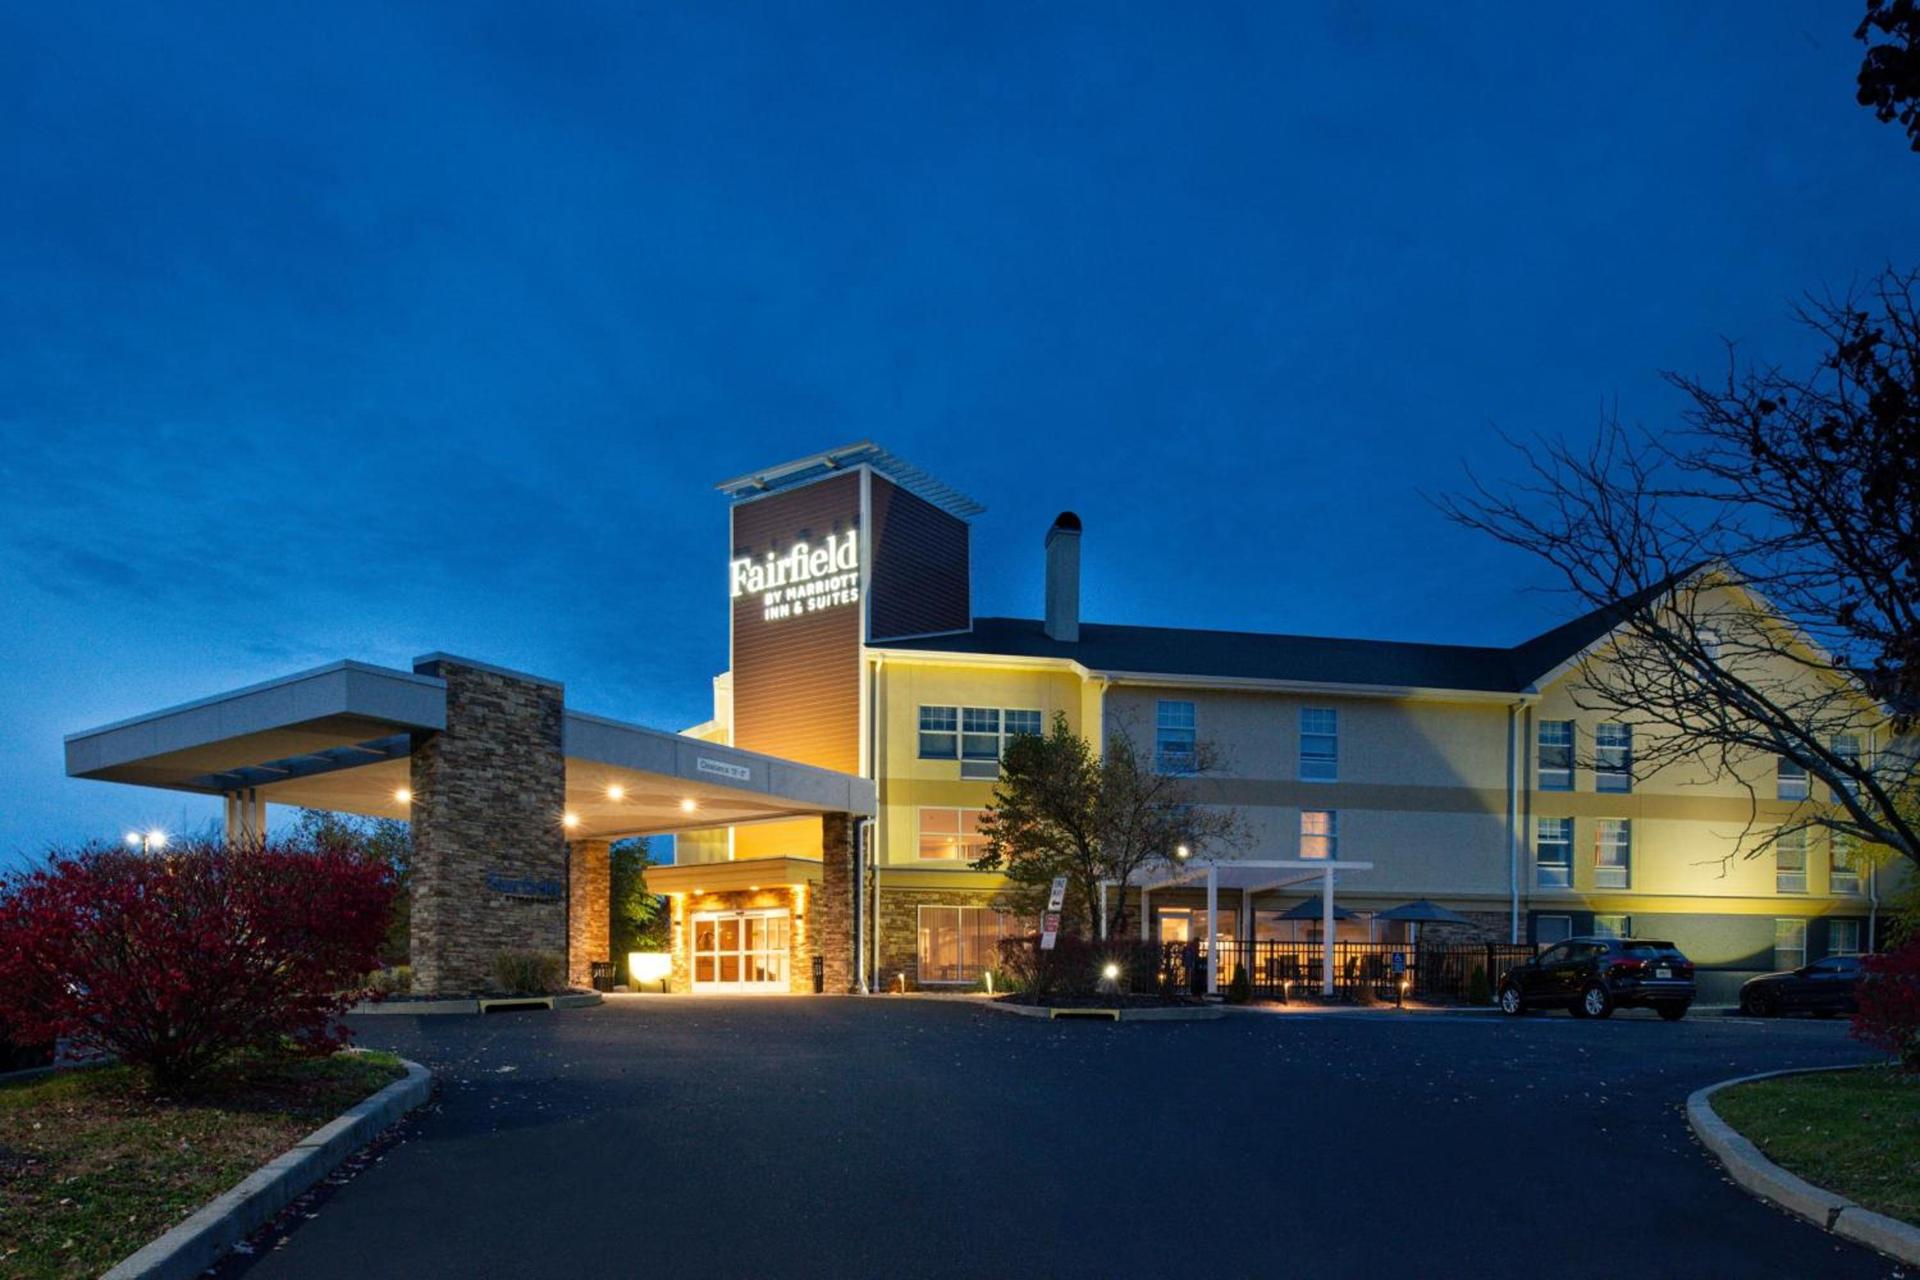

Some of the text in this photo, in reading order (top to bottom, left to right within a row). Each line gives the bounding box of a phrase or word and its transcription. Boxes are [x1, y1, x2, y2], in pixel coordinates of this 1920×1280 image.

[729, 529, 858, 597] Fairfield
[764, 573, 859, 606] BY MARRIOTT
[764, 588, 859, 621] INN & SUITES
